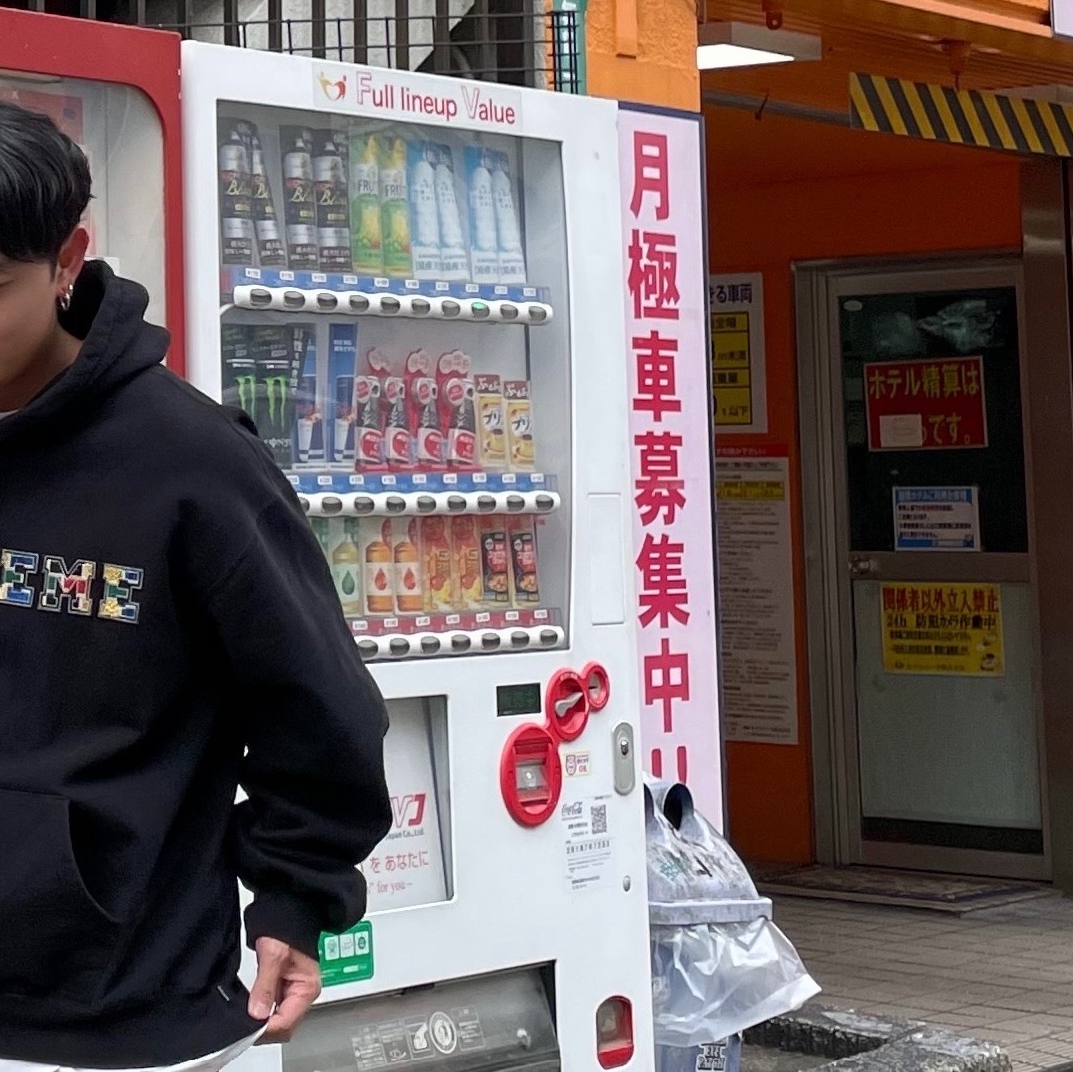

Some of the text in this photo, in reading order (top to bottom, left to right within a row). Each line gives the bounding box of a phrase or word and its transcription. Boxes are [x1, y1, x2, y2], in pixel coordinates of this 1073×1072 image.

[355, 71, 516, 125] Full lineup Value
[868, 362, 980, 400] ホテル精算は
[883, 587, 999, 613] 関係者以外立入禁止
[370, 851, 430, 874] を あなたに
[376, 881, 407, 895] for you
